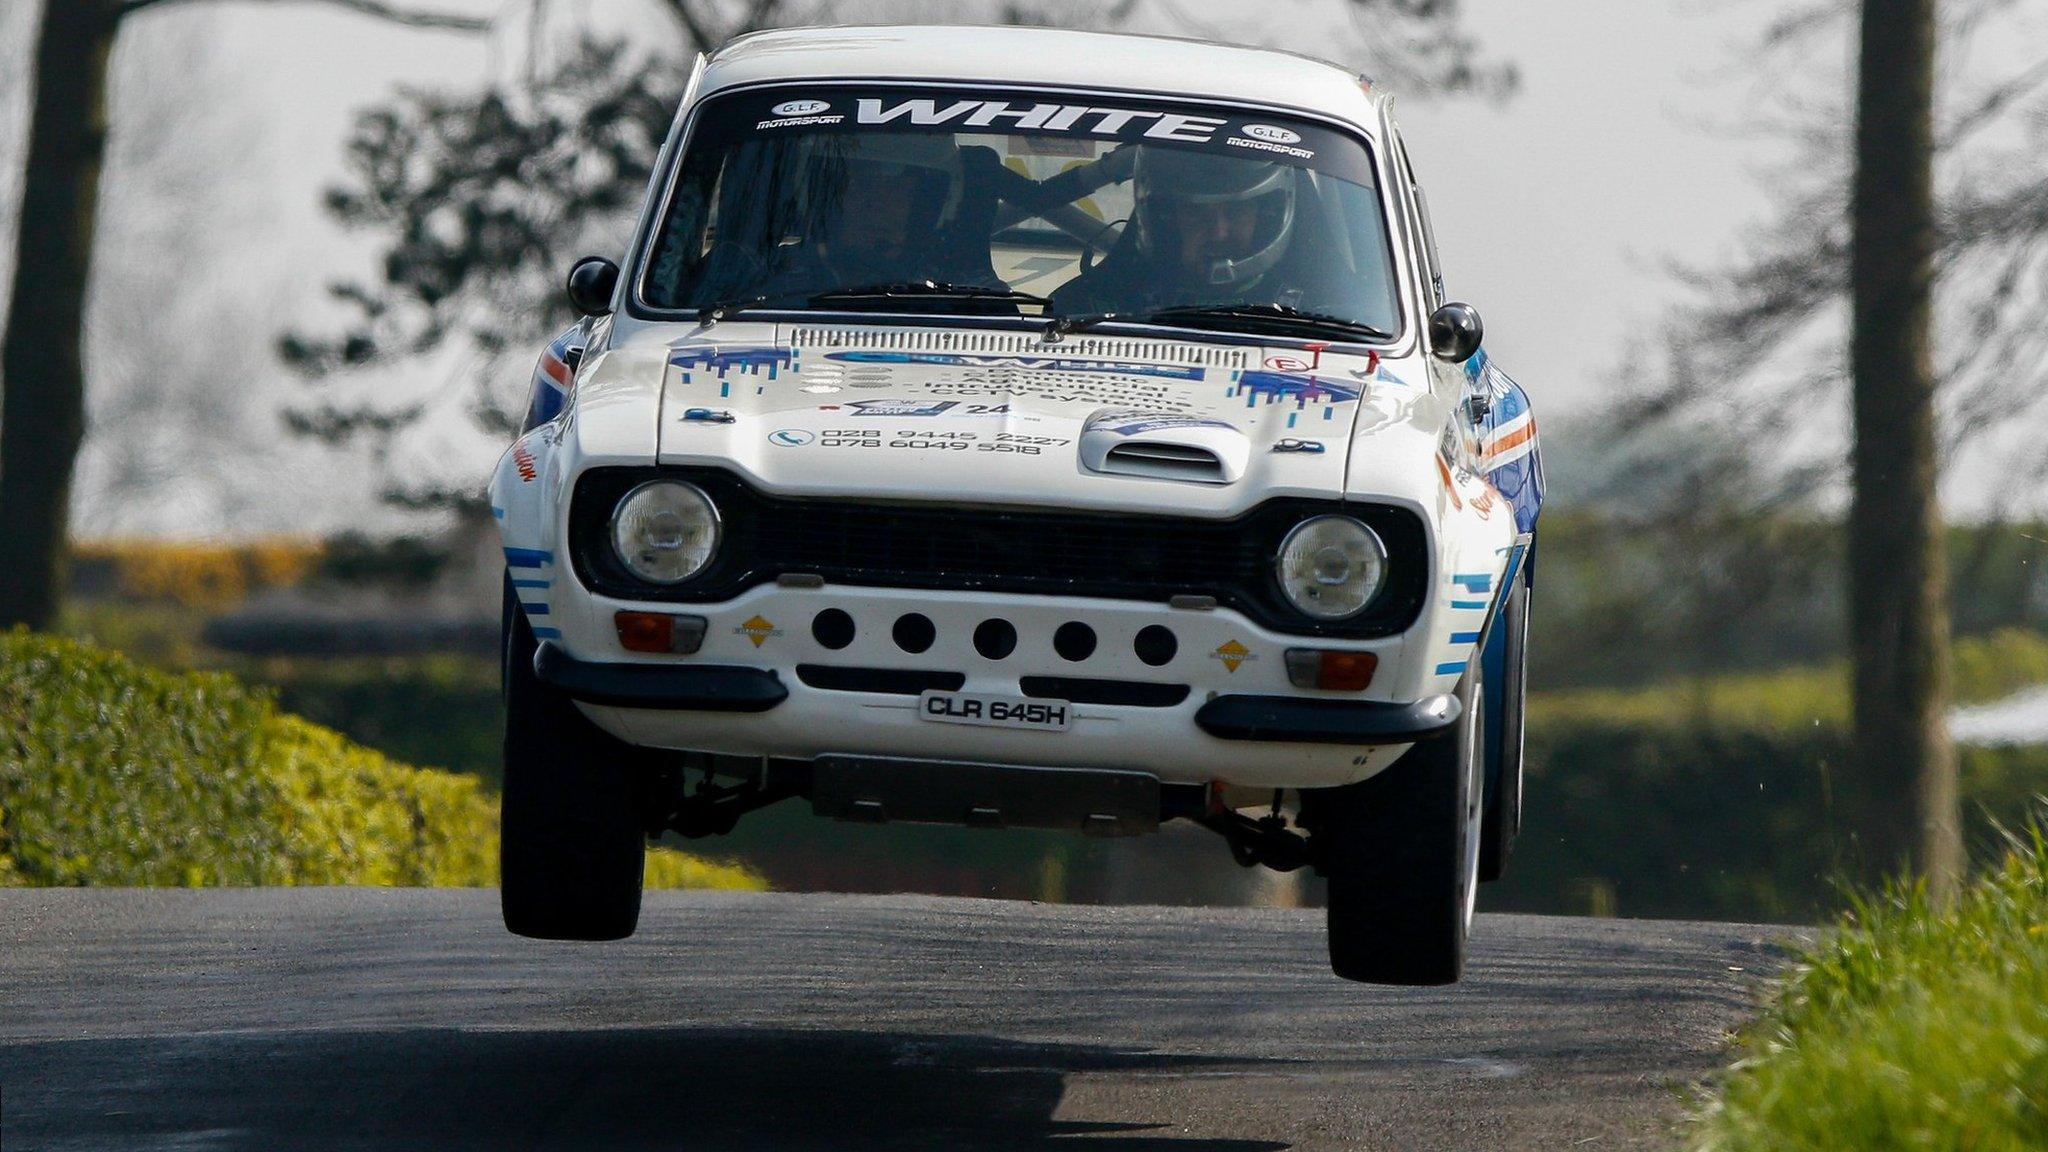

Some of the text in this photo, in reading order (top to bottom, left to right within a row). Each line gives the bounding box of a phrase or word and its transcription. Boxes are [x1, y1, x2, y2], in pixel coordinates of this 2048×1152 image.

[782, 102, 819, 113] G.L.F.
[756, 115, 844, 130] MOTORSPORT
[856, 98, 1228, 142] WHITE
[1253, 127, 1290, 140] G.L.F.
[1226, 136, 1315, 159] MOTORSPORT
[821, 438, 881, 448] 078
[889, 439, 969, 450] 6049
[897, 430, 977, 440] 9445
[996, 433, 1071, 446] 2227
[927, 696, 1066, 725] CLR 645H
